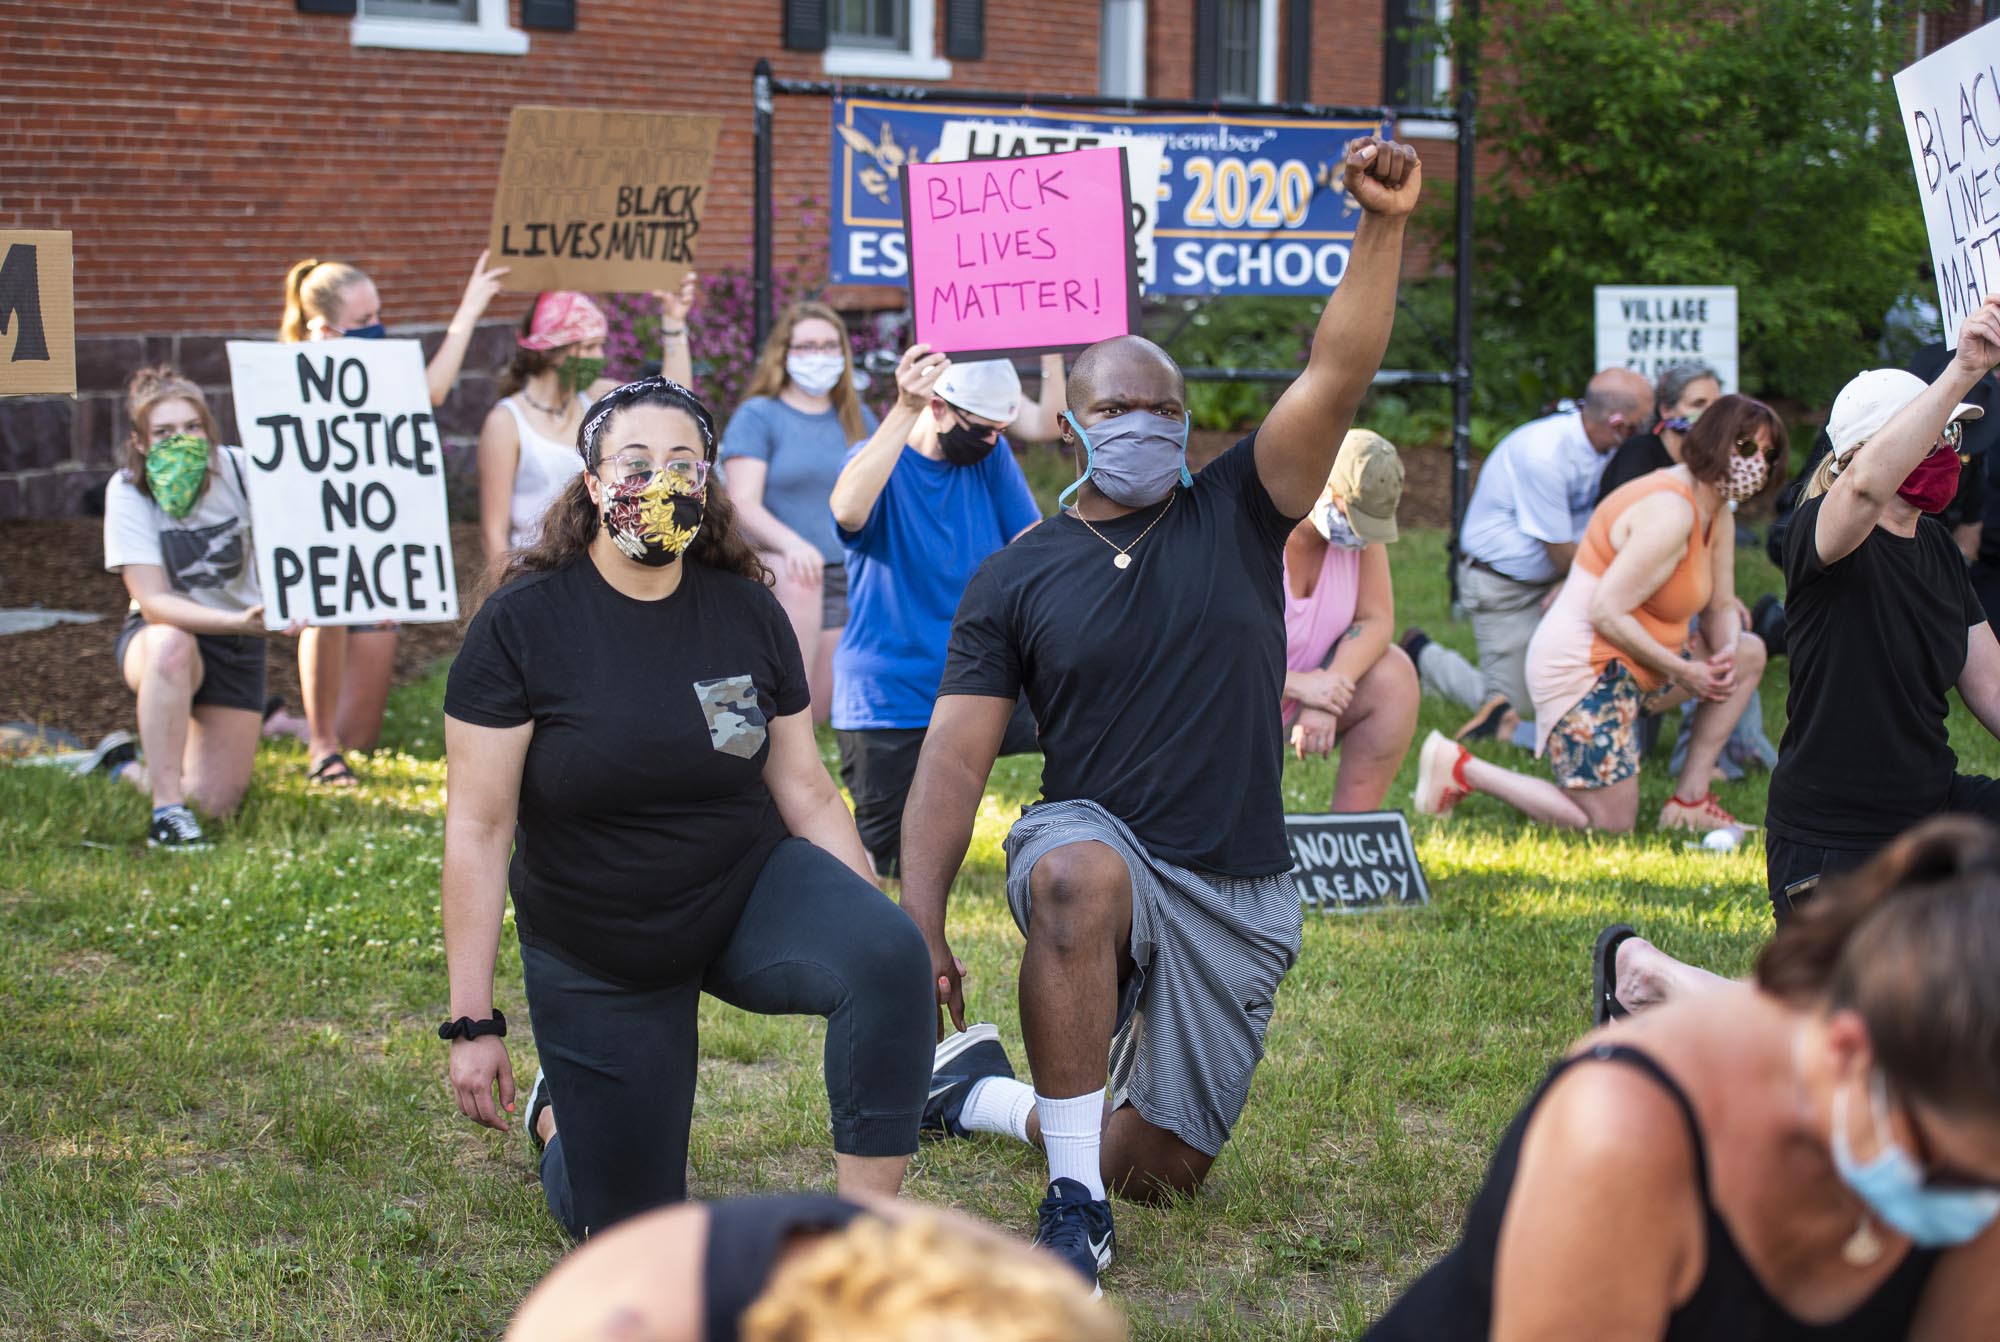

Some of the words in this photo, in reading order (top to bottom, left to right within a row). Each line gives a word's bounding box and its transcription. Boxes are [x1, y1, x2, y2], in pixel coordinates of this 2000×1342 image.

[616, 184, 702, 221] BLACK
[928, 168, 1070, 221] BLACK
[1183, 156, 1313, 228] 2020
[500, 221, 605, 260] LIVES
[604, 220, 700, 263] MATTER
[957, 227, 1057, 268] LIVES
[1172, 241, 1350, 287] SCHOO
[931, 278, 1100, 325] MATTER!
[1621, 299, 1708, 322] VILLAGE
[1629, 328, 1701, 351] OFFICE
[297, 352, 368, 408] NO
[252, 413, 437, 476] JUSTICE
[322, 479, 396, 532] NO
[273, 544, 448, 619] PEACE!
[1290, 832, 1405, 873] NOUGH
[1296, 869, 1408, 904] LREADY
